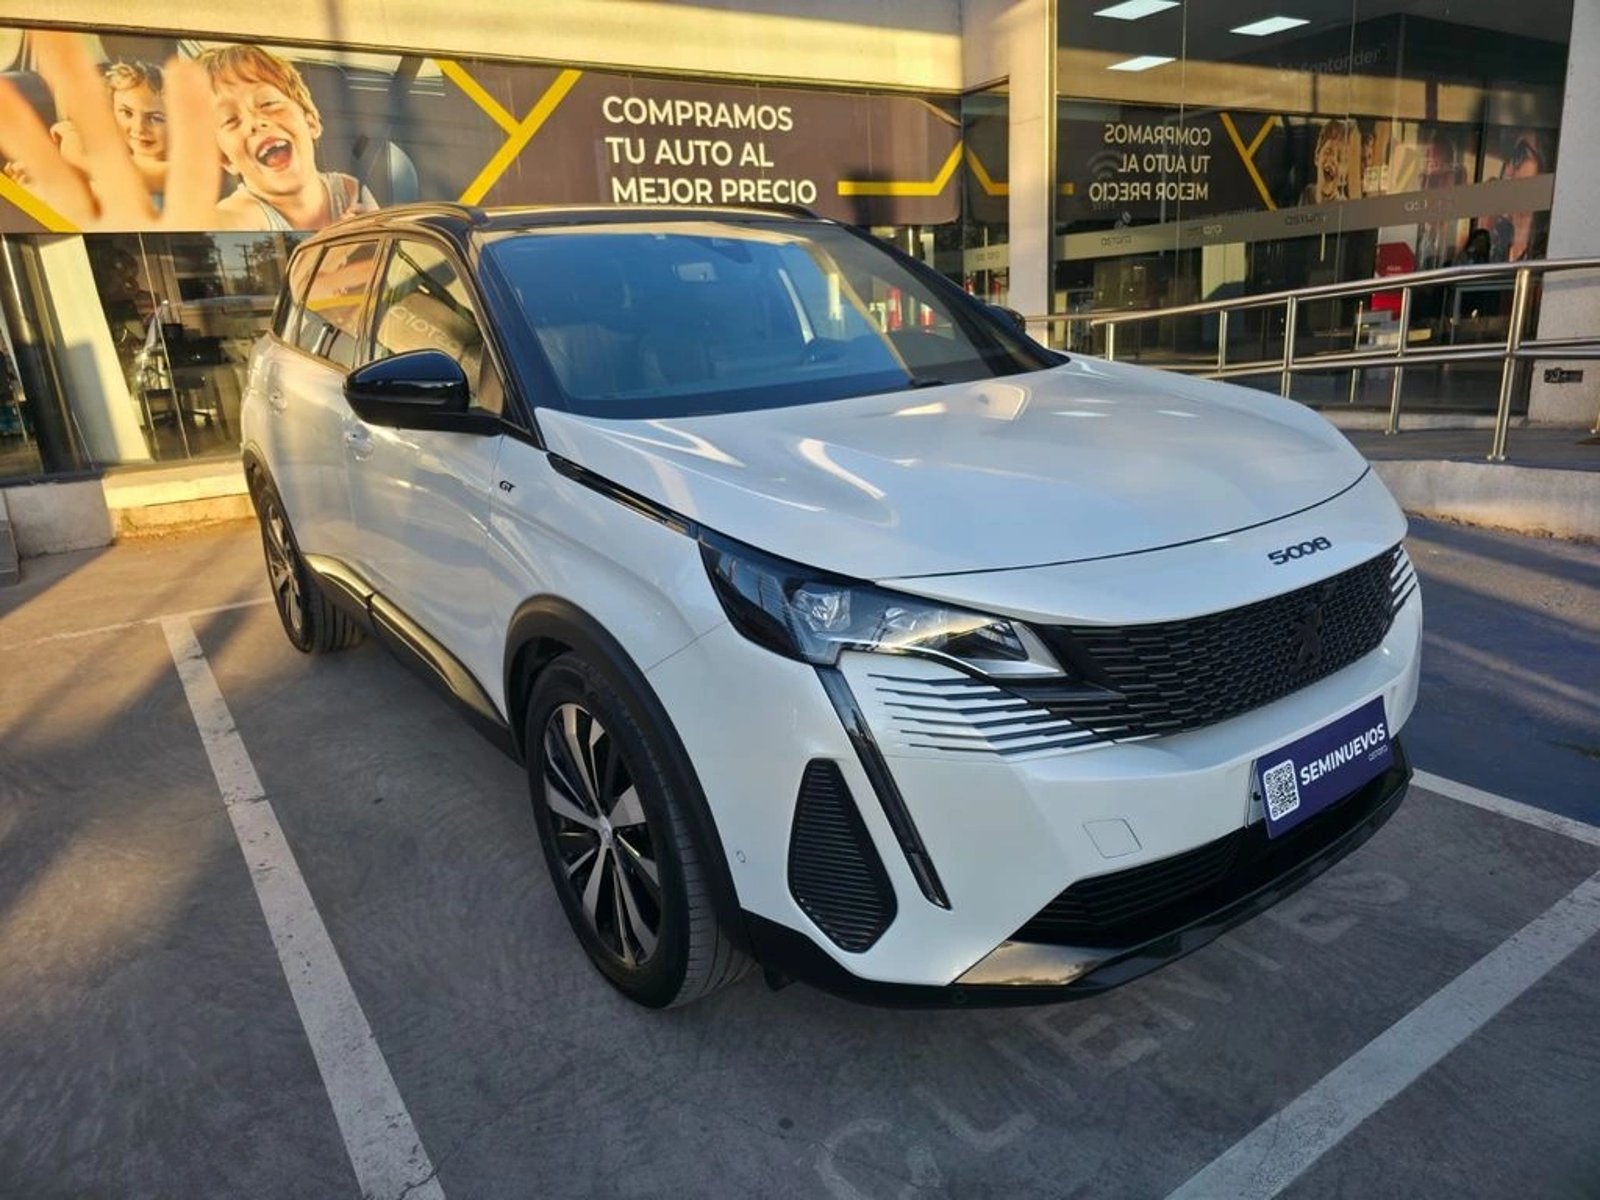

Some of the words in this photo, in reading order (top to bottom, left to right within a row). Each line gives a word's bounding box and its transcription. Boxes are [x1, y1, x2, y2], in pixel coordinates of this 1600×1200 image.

[602, 95, 793, 132] COMPRAMOS
[605, 136, 645, 164] TU
[654, 138, 733, 167] AUTO
[739, 142, 774, 168] AL
[612, 176, 714, 205] MEJOR
[720, 178, 817, 205] PRECIO
[499, 480, 516, 493] GT
[1268, 536, 1332, 565] 5008
[1301, 722, 1386, 786] SEMINUEVOS
